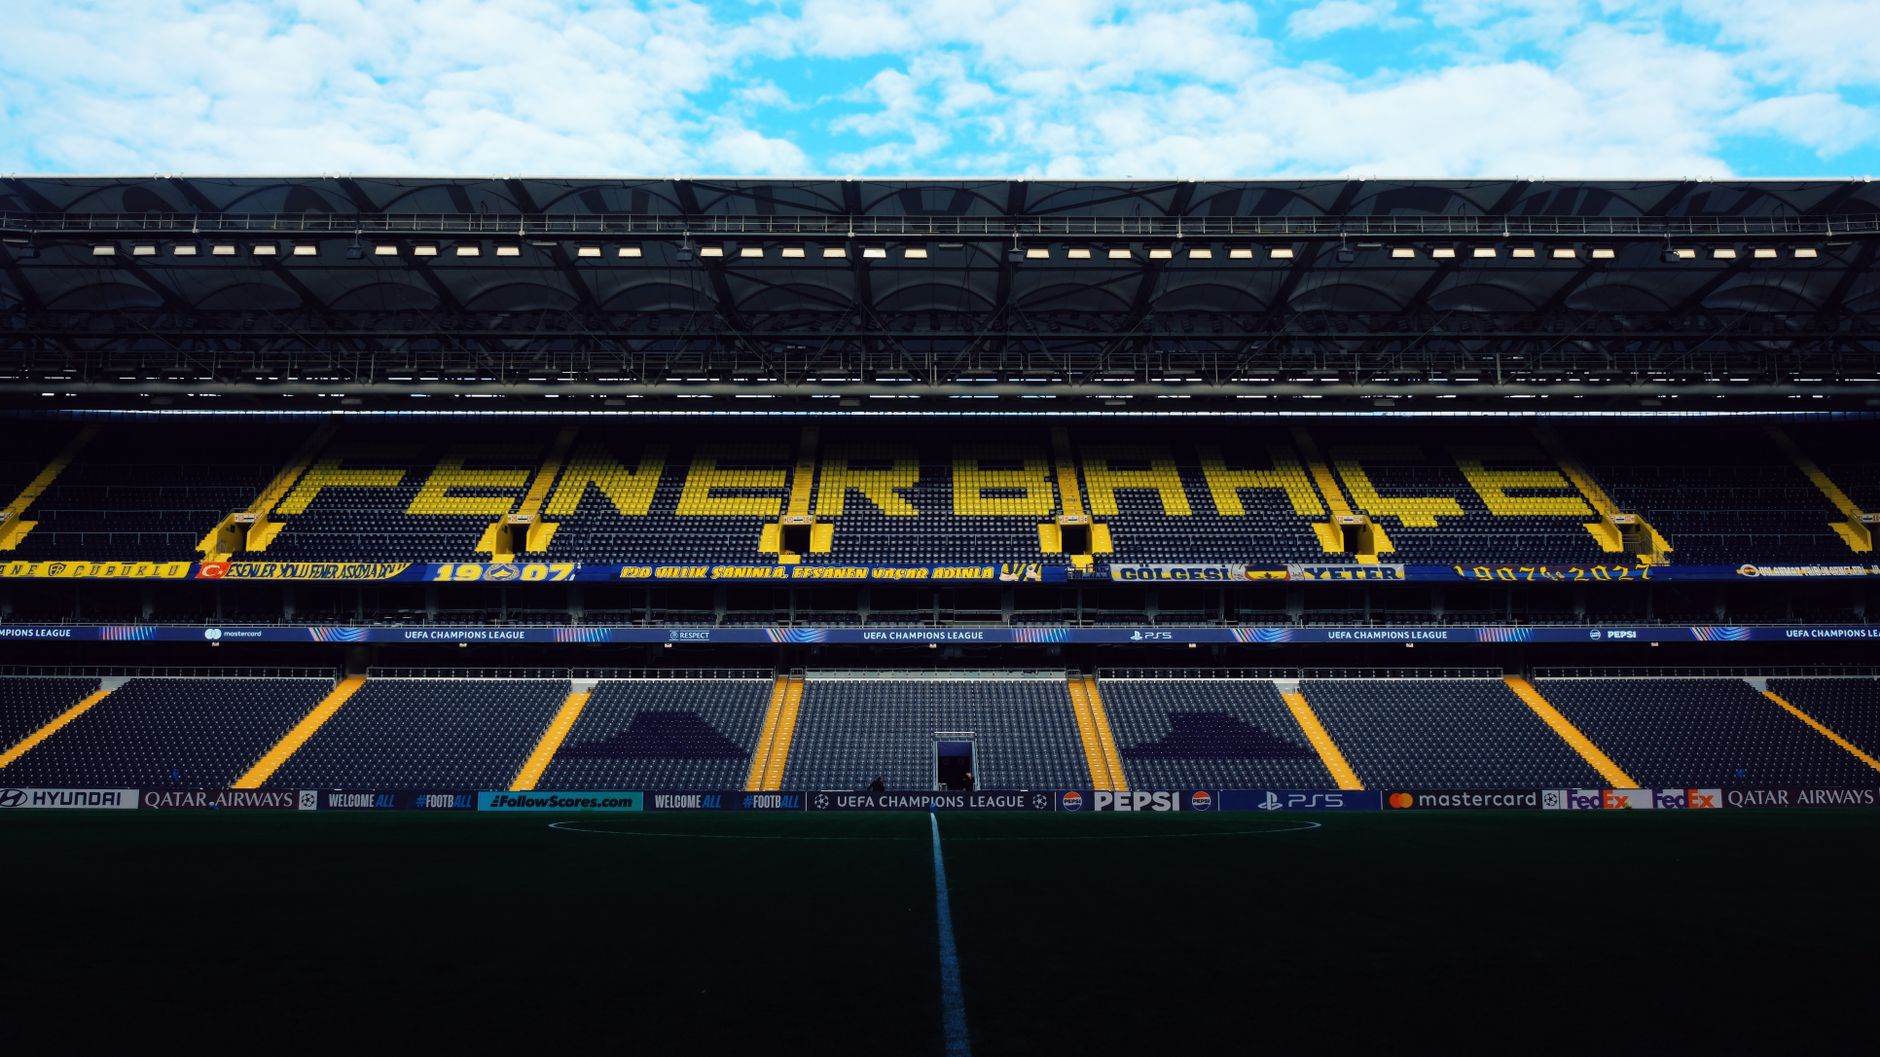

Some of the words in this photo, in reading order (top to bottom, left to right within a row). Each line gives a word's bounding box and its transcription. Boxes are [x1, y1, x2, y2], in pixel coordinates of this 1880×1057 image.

[433, 564, 483, 581] 19
[1120, 563, 1232, 580] GÖLGESİ
[1303, 566, 1402, 580] YETER
[35, 629, 71, 637] LEAGUE
[405, 631, 428, 639] UEFA
[431, 631, 487, 639] CHAMPIONS
[489, 631, 525, 639] LEAGUE
[863, 631, 887, 639] UEFA
[890, 631, 946, 639] CHAMPIONS
[947, 631, 984, 639] LEAGUE
[1328, 631, 1352, 639] UEFA
[1354, 631, 1410, 639] CHAMPIONS
[1411, 631, 1448, 639] LEAGUE
[1607, 631, 1637, 639] PEPSI
[1786, 629, 1810, 638] UEFA
[1812, 629, 1866, 638] CHAMPIONS
[33, 792, 120, 806] HYUNDAI
[145, 792, 207, 809] QATAR
[215, 793, 293, 807] AIRWAYS
[329, 794, 375, 808] WELCOME
[375, 794, 395, 808] ALL
[416, 794, 472, 808] #FOOTBALL
[655, 795, 702, 808] WELCOME
[702, 795, 721, 808] ALL
[743, 795, 800, 808] #FOOTBALL
[837, 795, 875, 808] UEFA
[879, 795, 964, 808] CHAMPIONS
[970, 795, 1025, 808] LEAGUE
[1094, 792, 1180, 811] PEPSI
[1288, 794, 1344, 808] PS5
[1419, 791, 1537, 807] mastercard
[1567, 789, 1629, 809] FedEx
[1653, 788, 1713, 808] FedEx
[1728, 790, 1789, 808] QATAR
[1797, 790, 1874, 805] AIRWAYS
